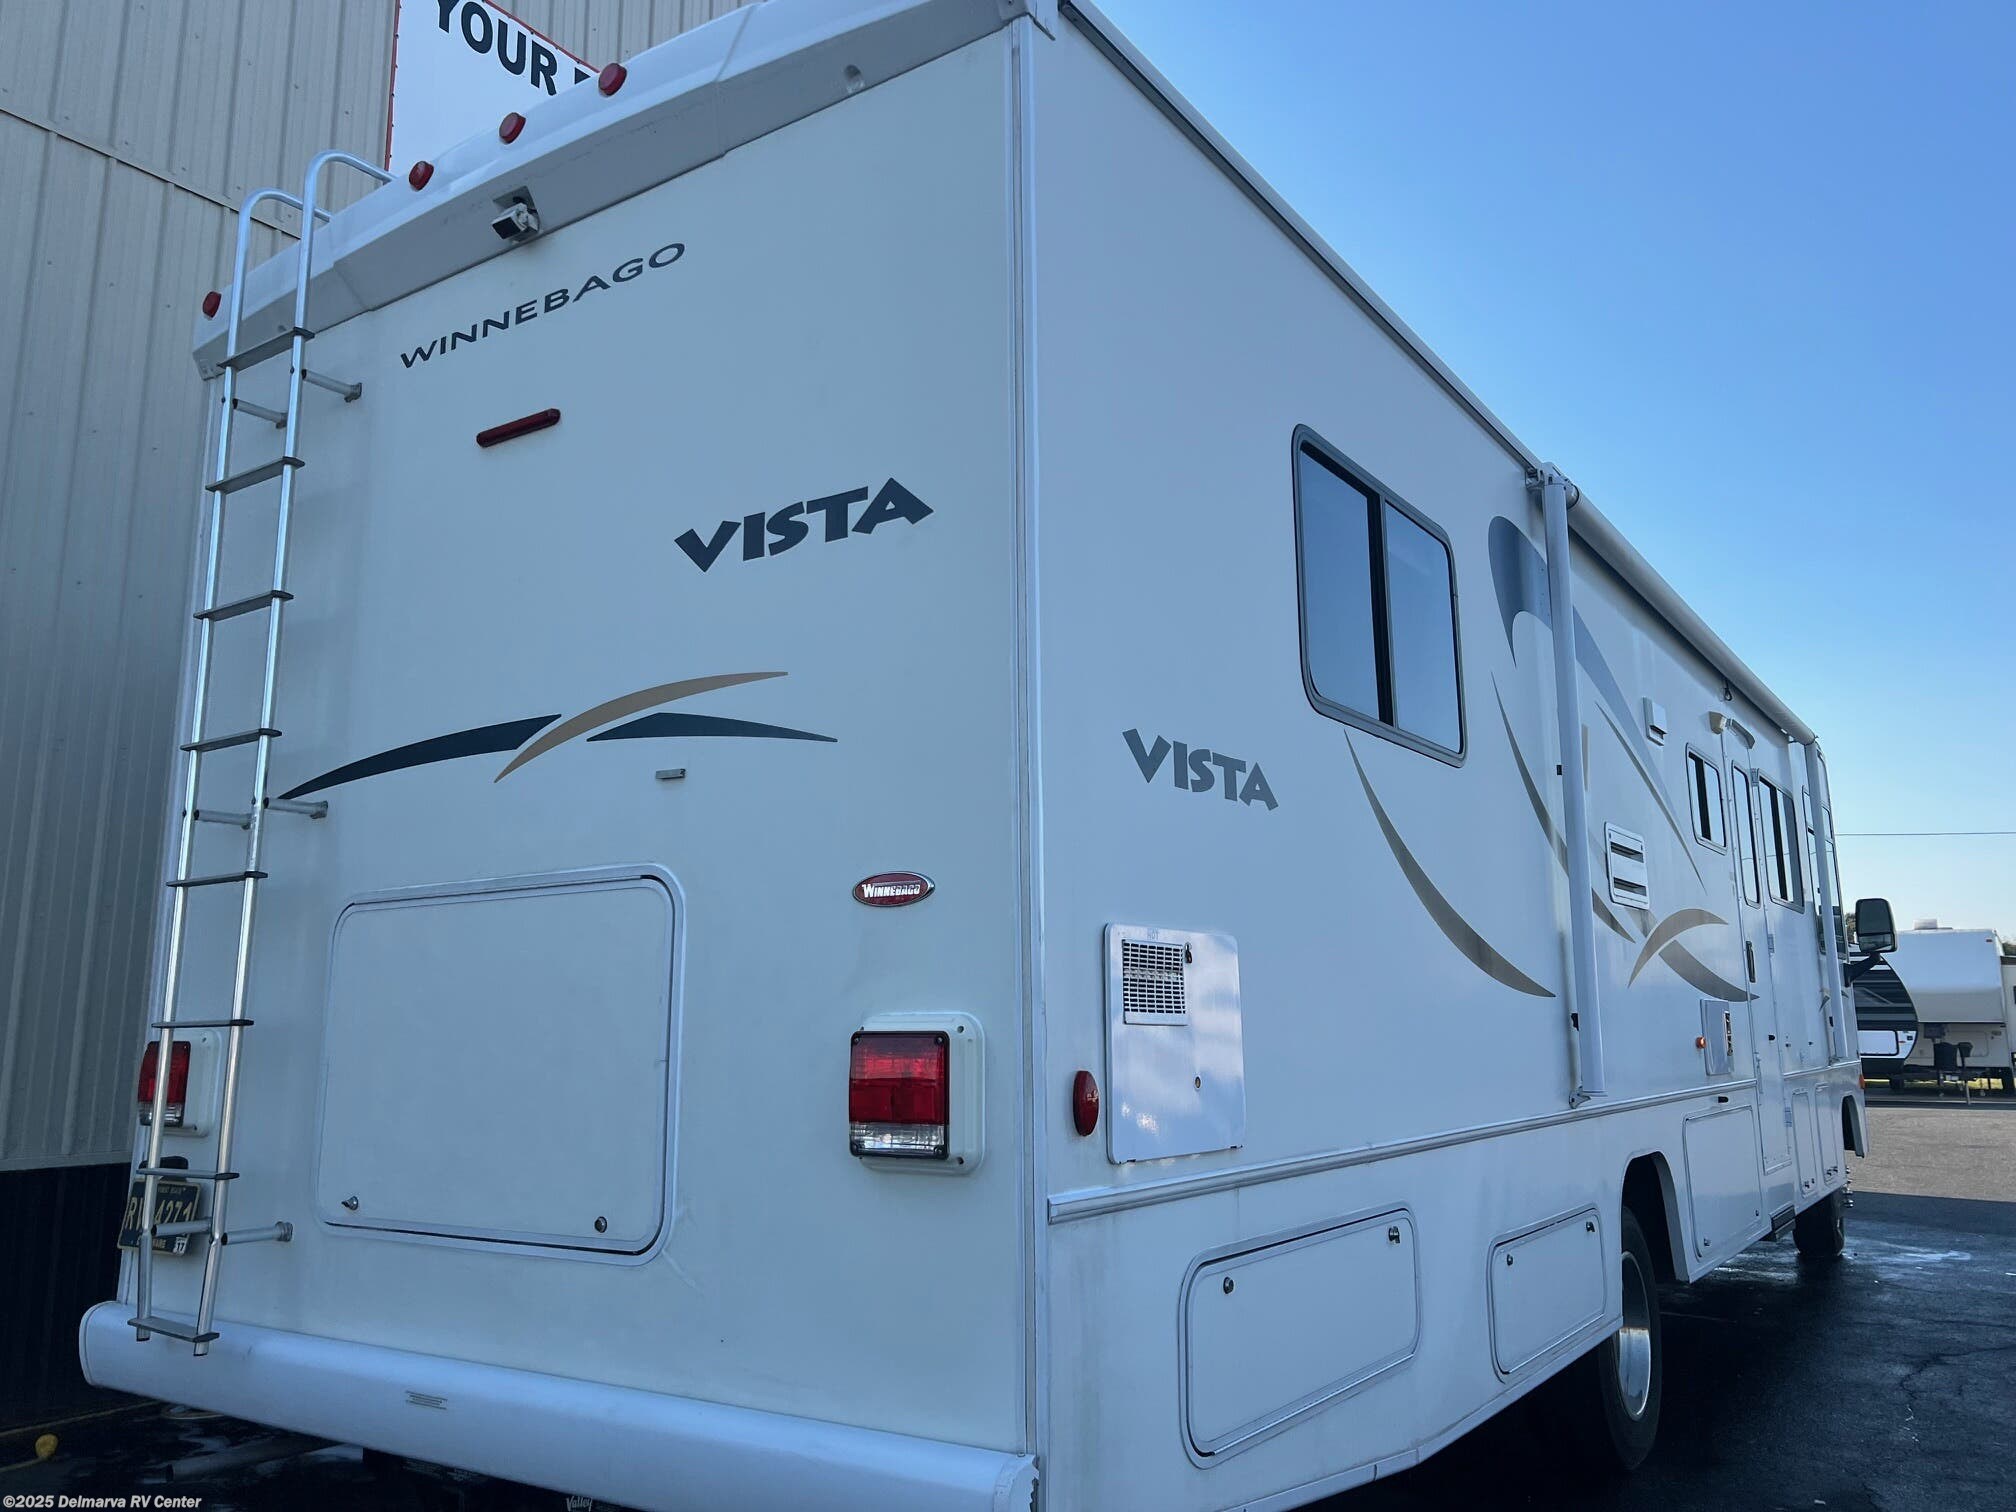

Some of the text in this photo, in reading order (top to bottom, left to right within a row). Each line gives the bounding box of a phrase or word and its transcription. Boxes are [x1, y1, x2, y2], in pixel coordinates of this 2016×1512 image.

[437, 0, 557, 96] YOUR
[400, 243, 685, 368] WINNEBAGO
[674, 477, 934, 573] VISTA
[1122, 728, 1279, 811] VISTA
